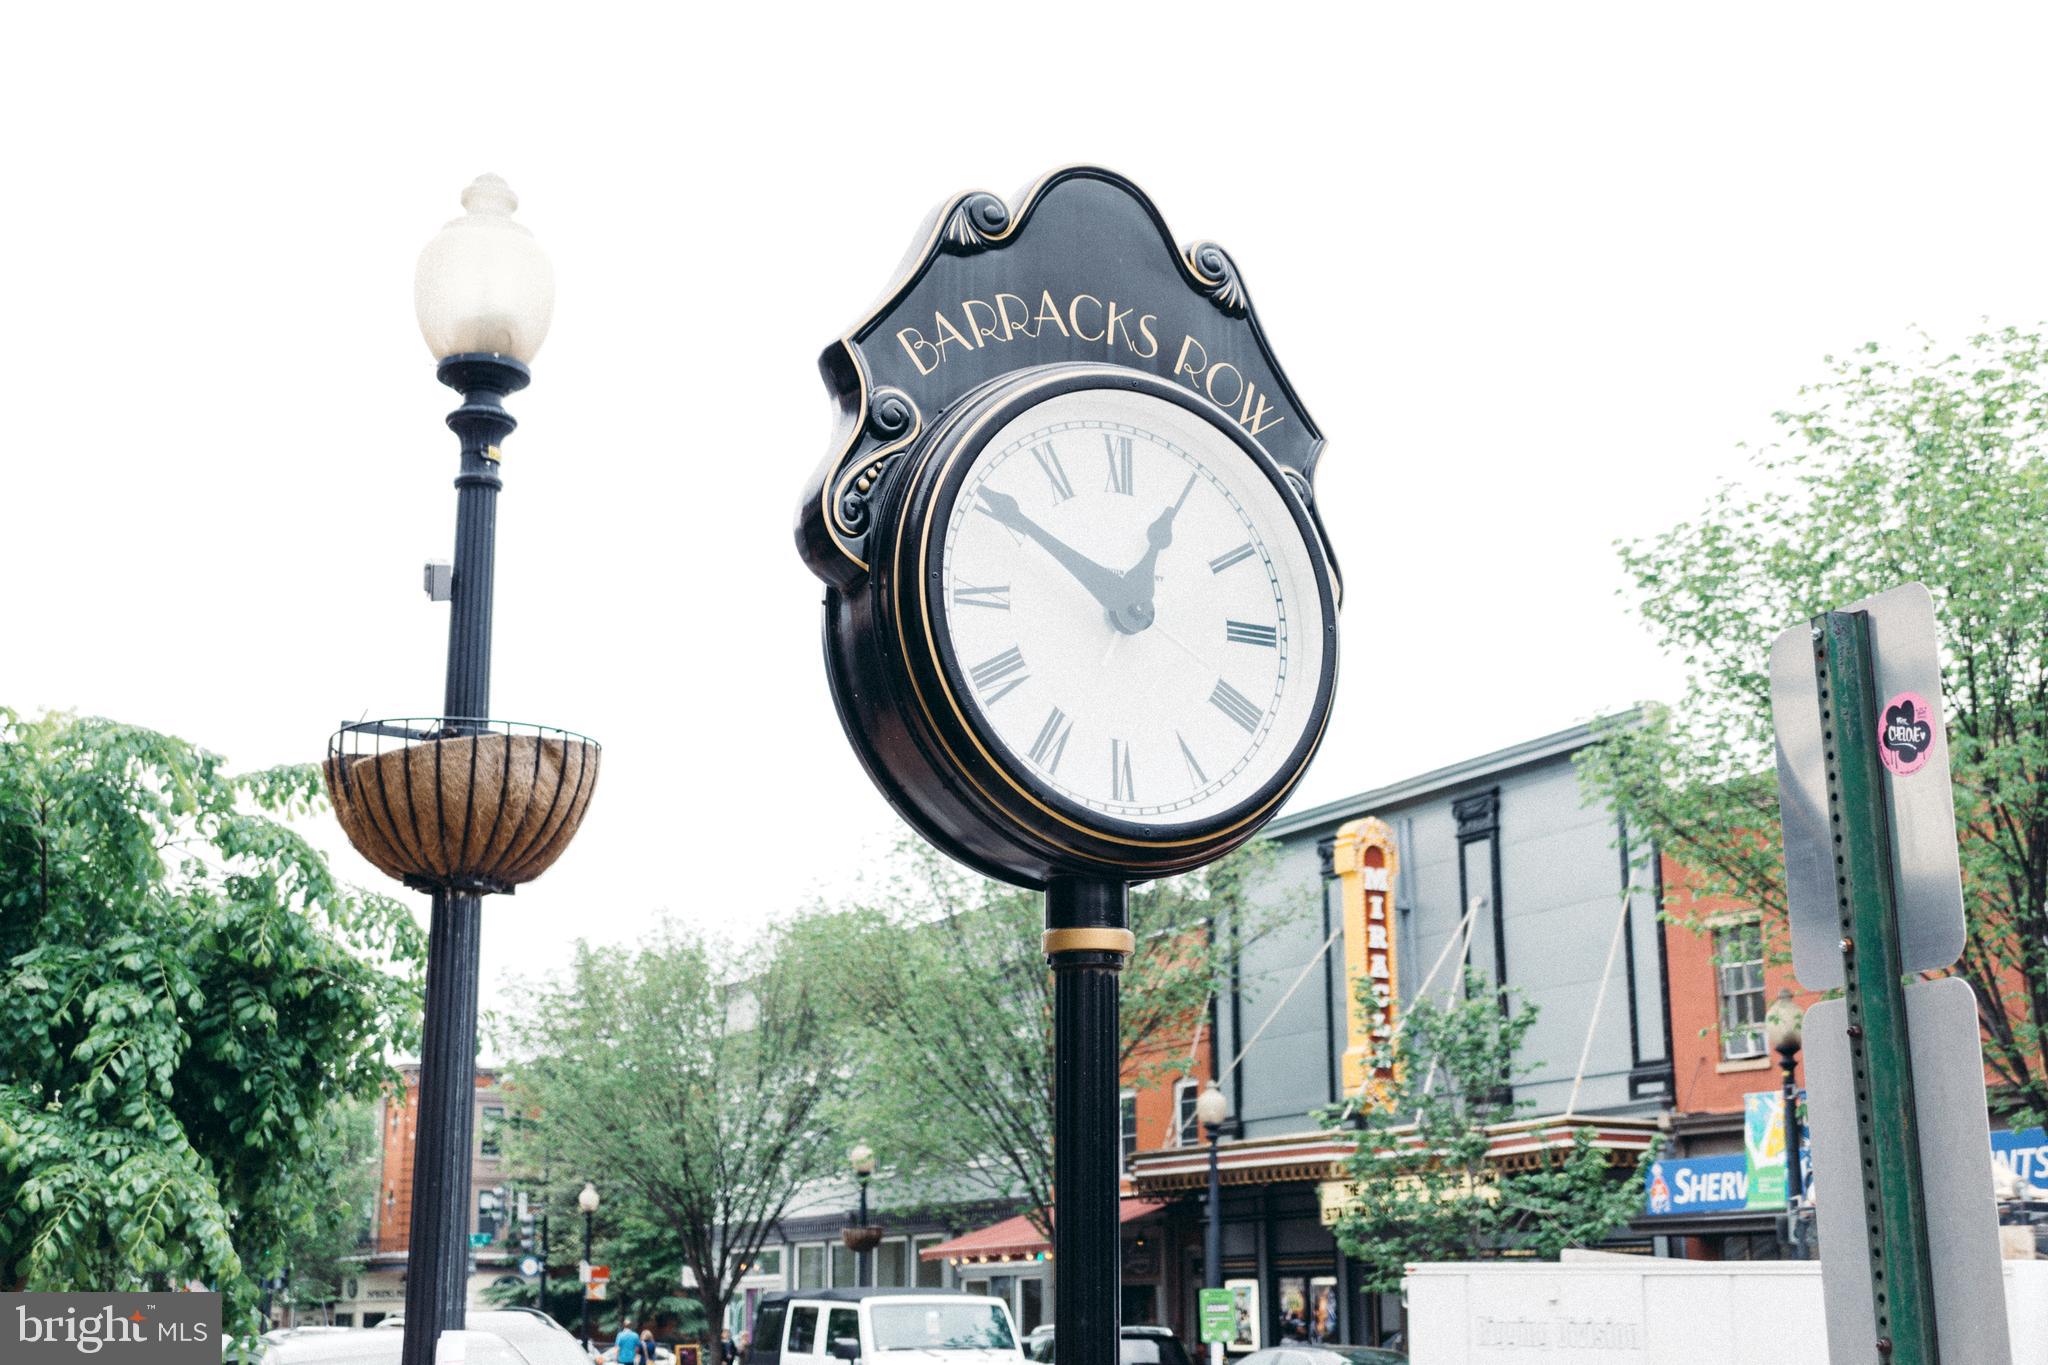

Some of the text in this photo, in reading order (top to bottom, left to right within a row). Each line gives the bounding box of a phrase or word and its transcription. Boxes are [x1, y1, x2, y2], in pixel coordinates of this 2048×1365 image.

[896, 289, 1285, 437] BARRACKS ROW
[1030, 440, 1076, 506] XI
[1103, 433, 1134, 496] XII
[1207, 541, 1257, 576] II
[953, 575, 1011, 611] IX
[1226, 617, 1277, 649] III
[969, 643, 1032, 708] VIII
[1026, 705, 1075, 776] VII
[1111, 738, 1136, 802] VI
[1175, 729, 1210, 790] V
[1991, 1145, 2048, 1179] NTS
